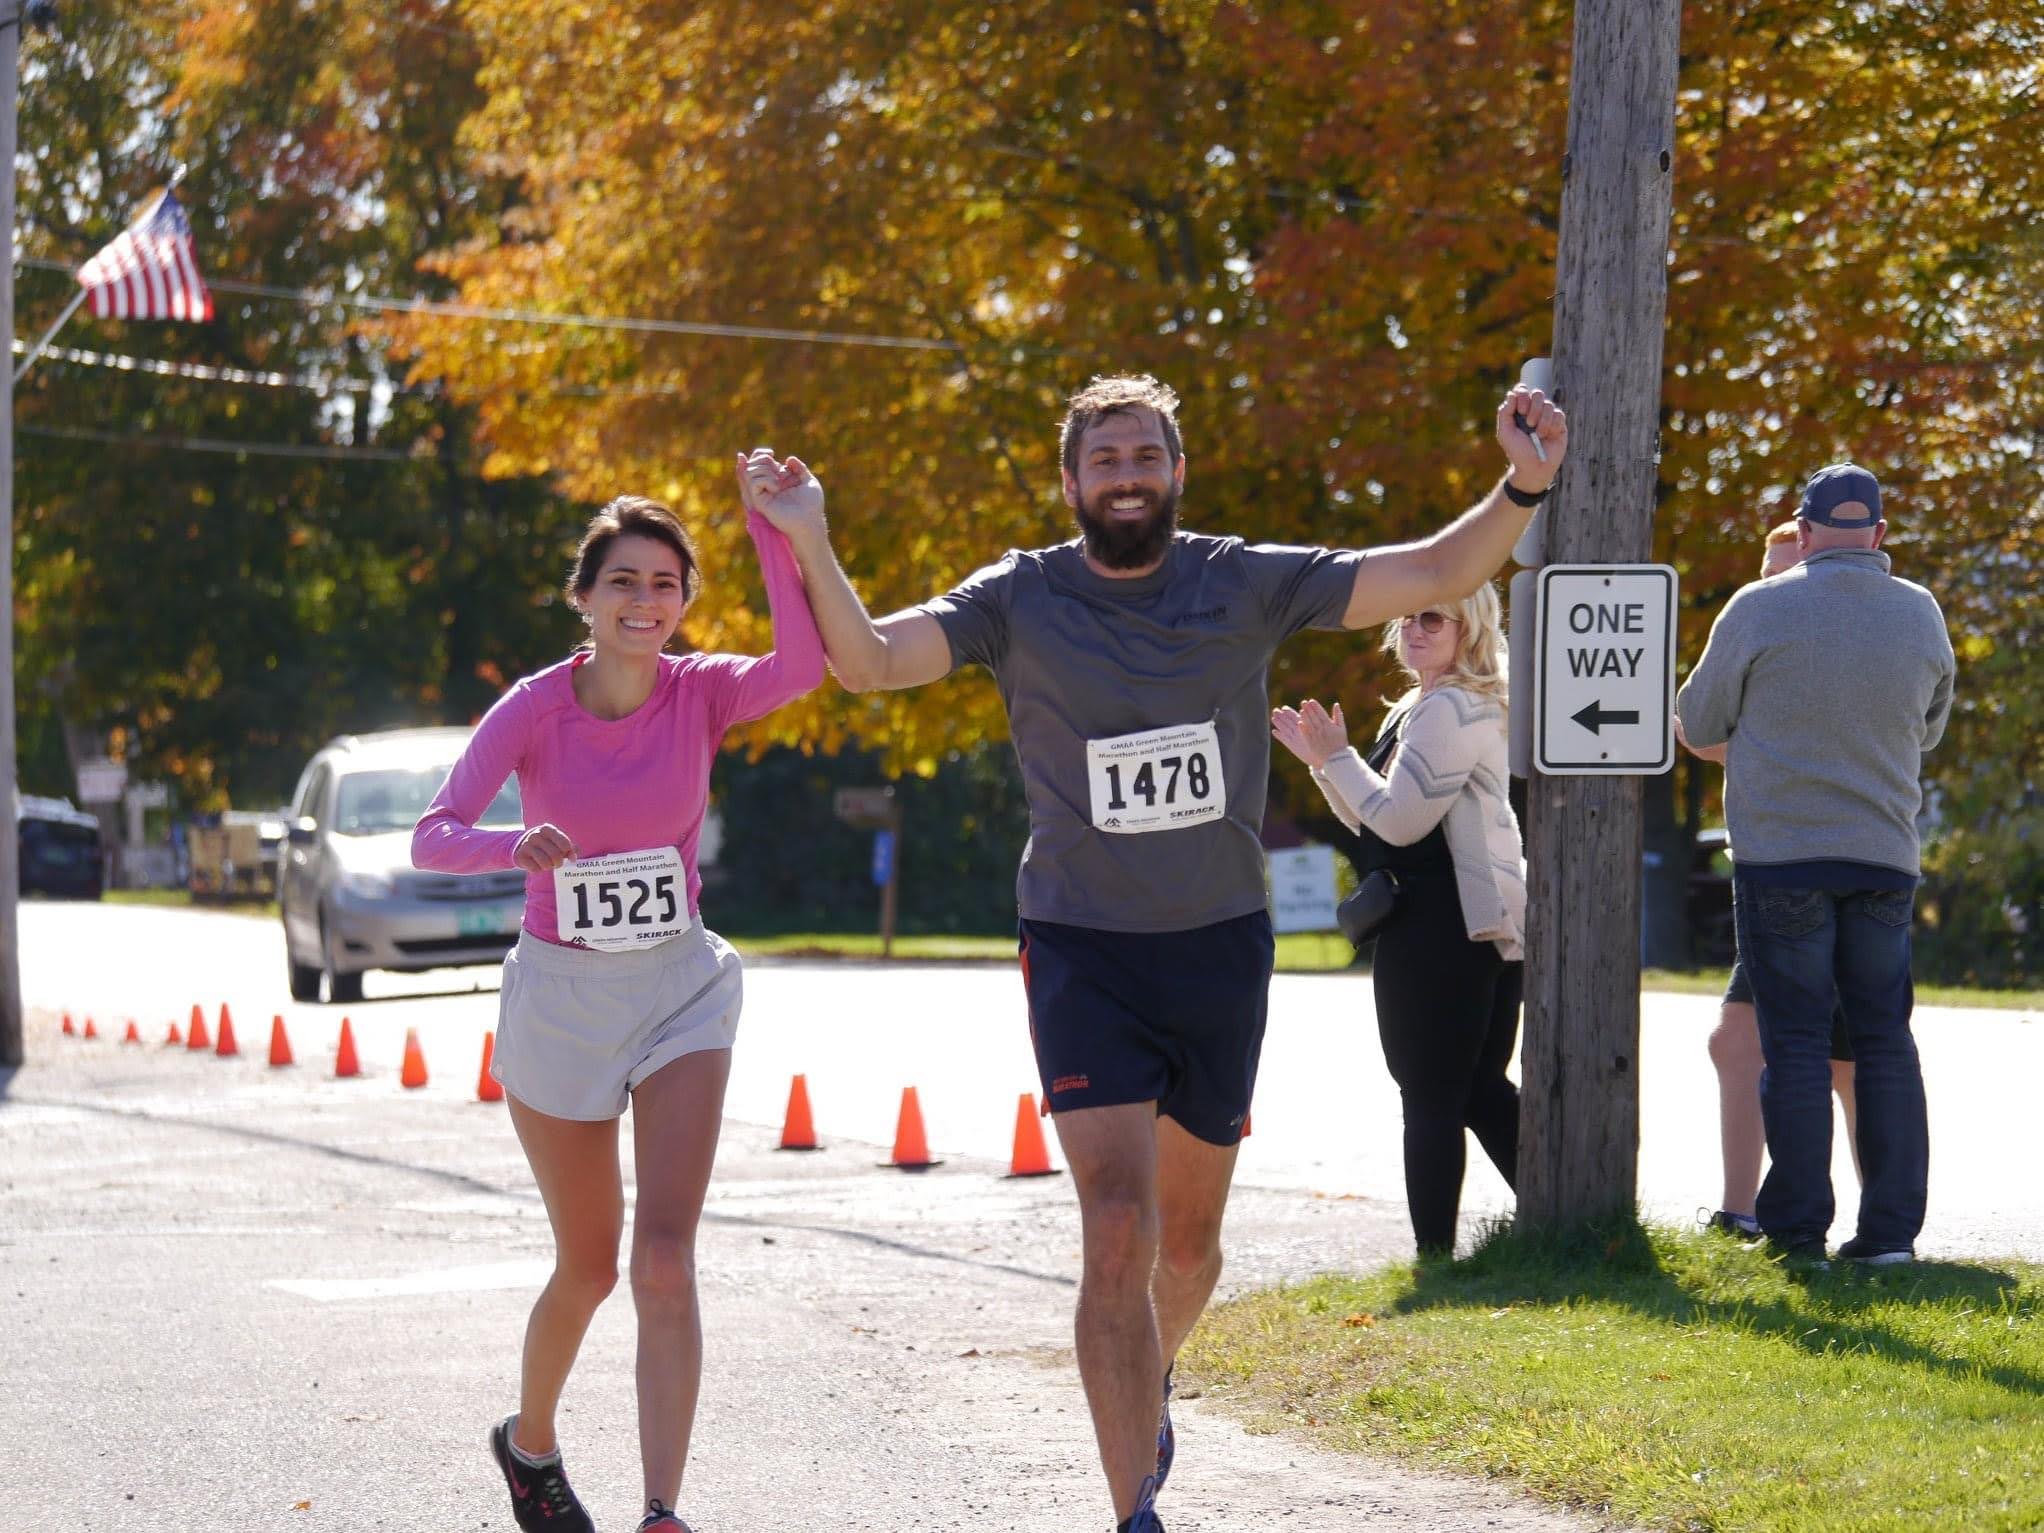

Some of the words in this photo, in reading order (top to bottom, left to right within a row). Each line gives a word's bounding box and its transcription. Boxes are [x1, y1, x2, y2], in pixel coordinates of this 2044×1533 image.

[1569, 603, 1644, 634] ONE
[1567, 648, 1645, 678] WAY
[1098, 750, 1138, 759] Marathon
[1156, 744, 1172, 752] Half
[1173, 738, 1210, 748] Marathon
[1110, 742, 1134, 750] GMAA
[1135, 738, 1159, 746] Green
[1160, 731, 1197, 742] Mountain
[1105, 752, 1210, 811] 1478
[1170, 805, 1216, 819] SKIRACK
[564, 869, 604, 877] Marathon
[640, 861, 678, 871] Marathon
[602, 858, 625, 867] Green
[626, 854, 665, 863] Mountain
[573, 875, 677, 929] 1525
[636, 928, 682, 940] SKIRACK
